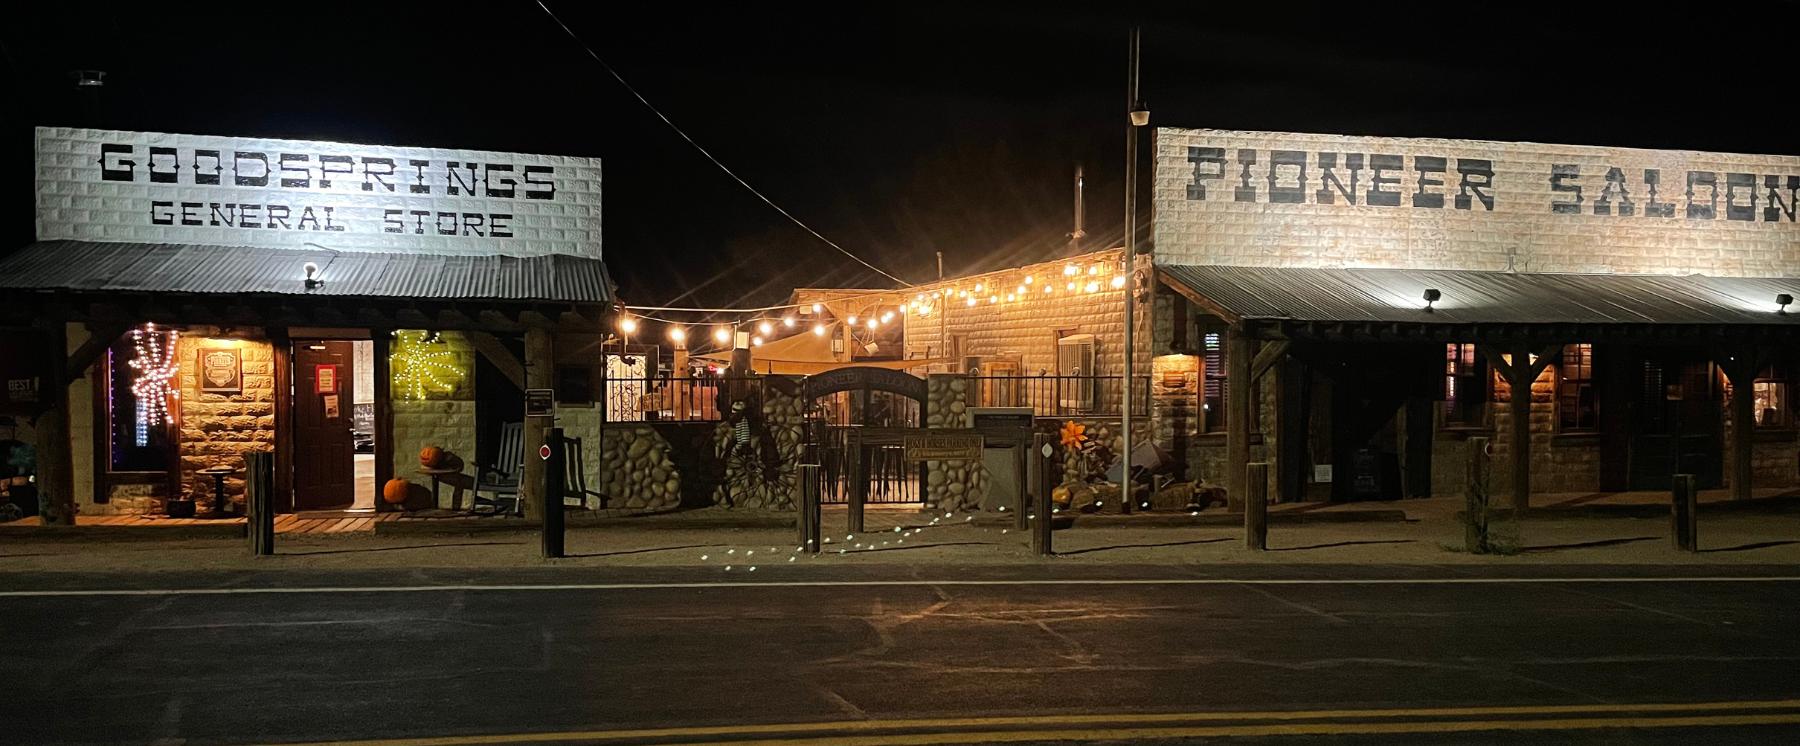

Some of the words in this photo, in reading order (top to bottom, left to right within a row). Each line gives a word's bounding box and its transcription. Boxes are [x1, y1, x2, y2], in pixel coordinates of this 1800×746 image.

[98, 143, 556, 200] GOODSPRINGS
[1186, 146, 1496, 212] PIONEER
[1549, 163, 1800, 222] SALOON
[150, 200, 345, 231] GENERAL
[383, 209, 513, 237] STORE
[8, 379, 31, 391] BEST
[810, 373, 863, 392] PIONEER
[868, 373, 922, 394] SALOON
